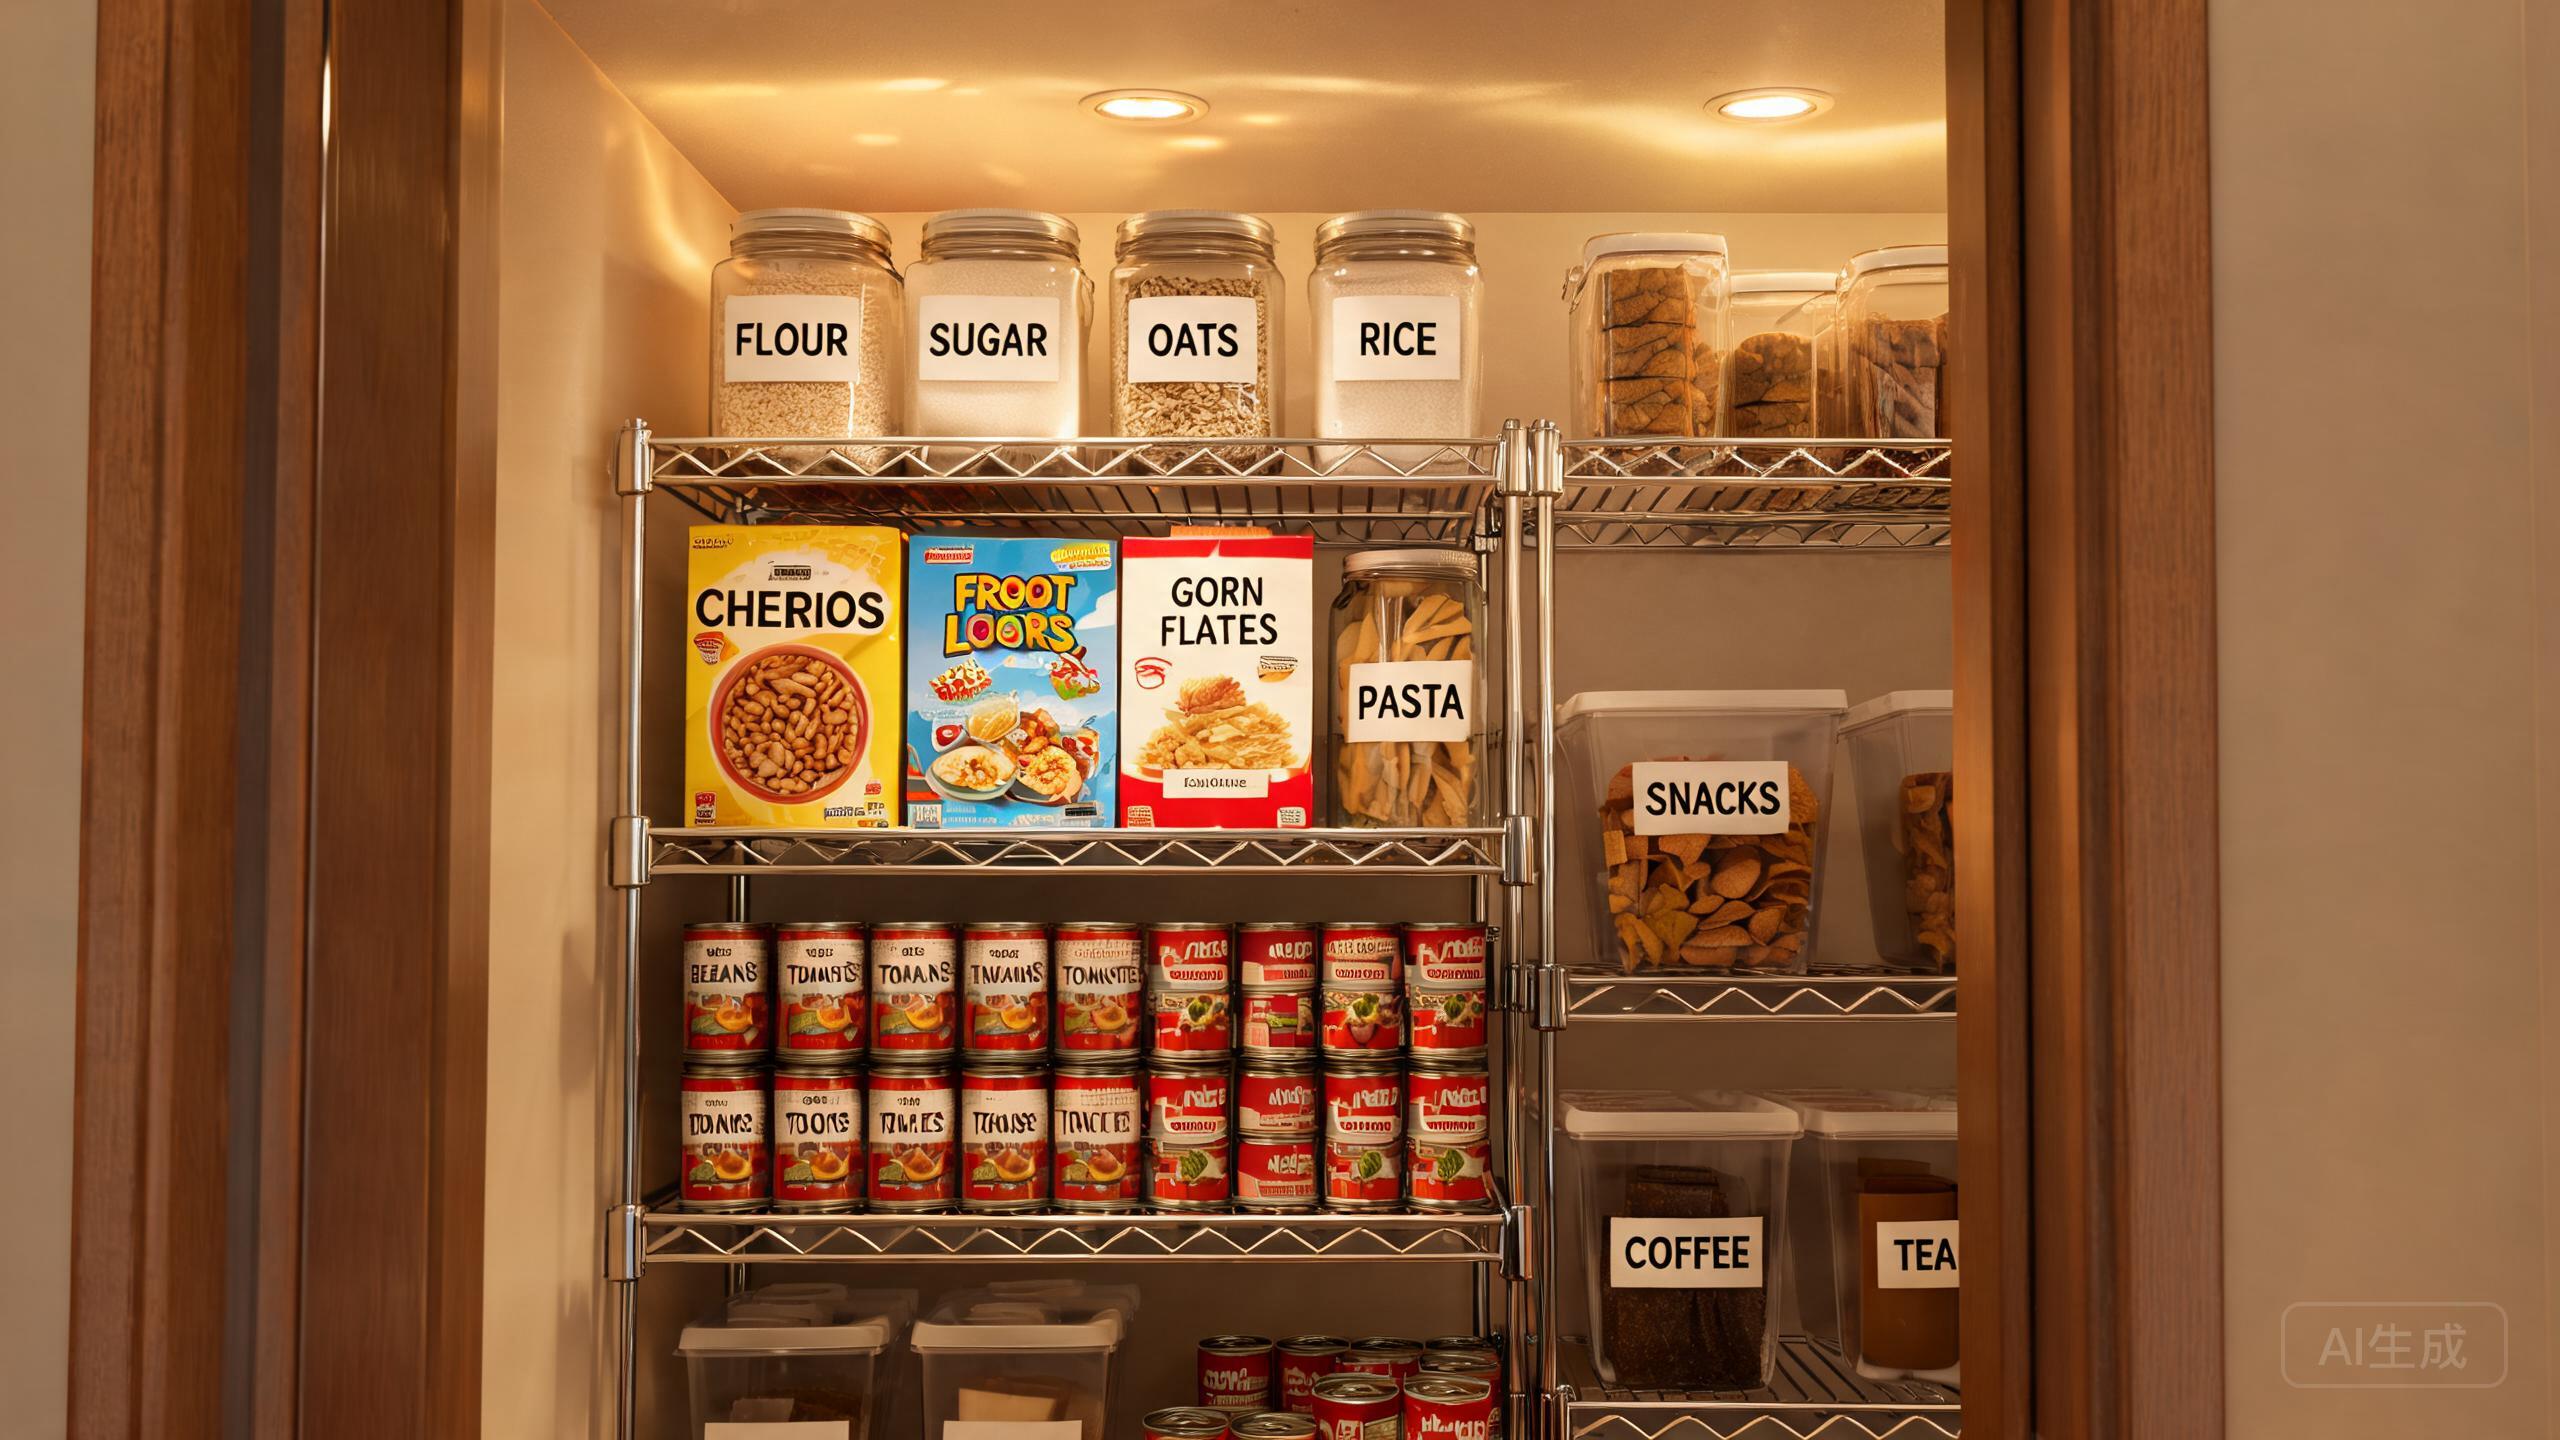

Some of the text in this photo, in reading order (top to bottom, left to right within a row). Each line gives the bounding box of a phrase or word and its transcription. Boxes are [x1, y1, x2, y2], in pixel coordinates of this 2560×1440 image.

[736, 322, 848, 357] FLOUR
[929, 322, 1048, 357] SUGAR
[1148, 322, 1239, 358] OATS
[1360, 321, 1437, 357] RICE
[695, 588, 885, 629] CHERIOS
[954, 572, 1079, 614] FROOT
[1171, 576, 1263, 608] GORN
[1161, 612, 1278, 647] FLATES
[1358, 683, 1465, 720] PASTA
[1645, 780, 1781, 816] SNACKS
[1625, 1235, 1751, 1270] COFFEE
[1893, 1238, 1957, 1271] TEA
